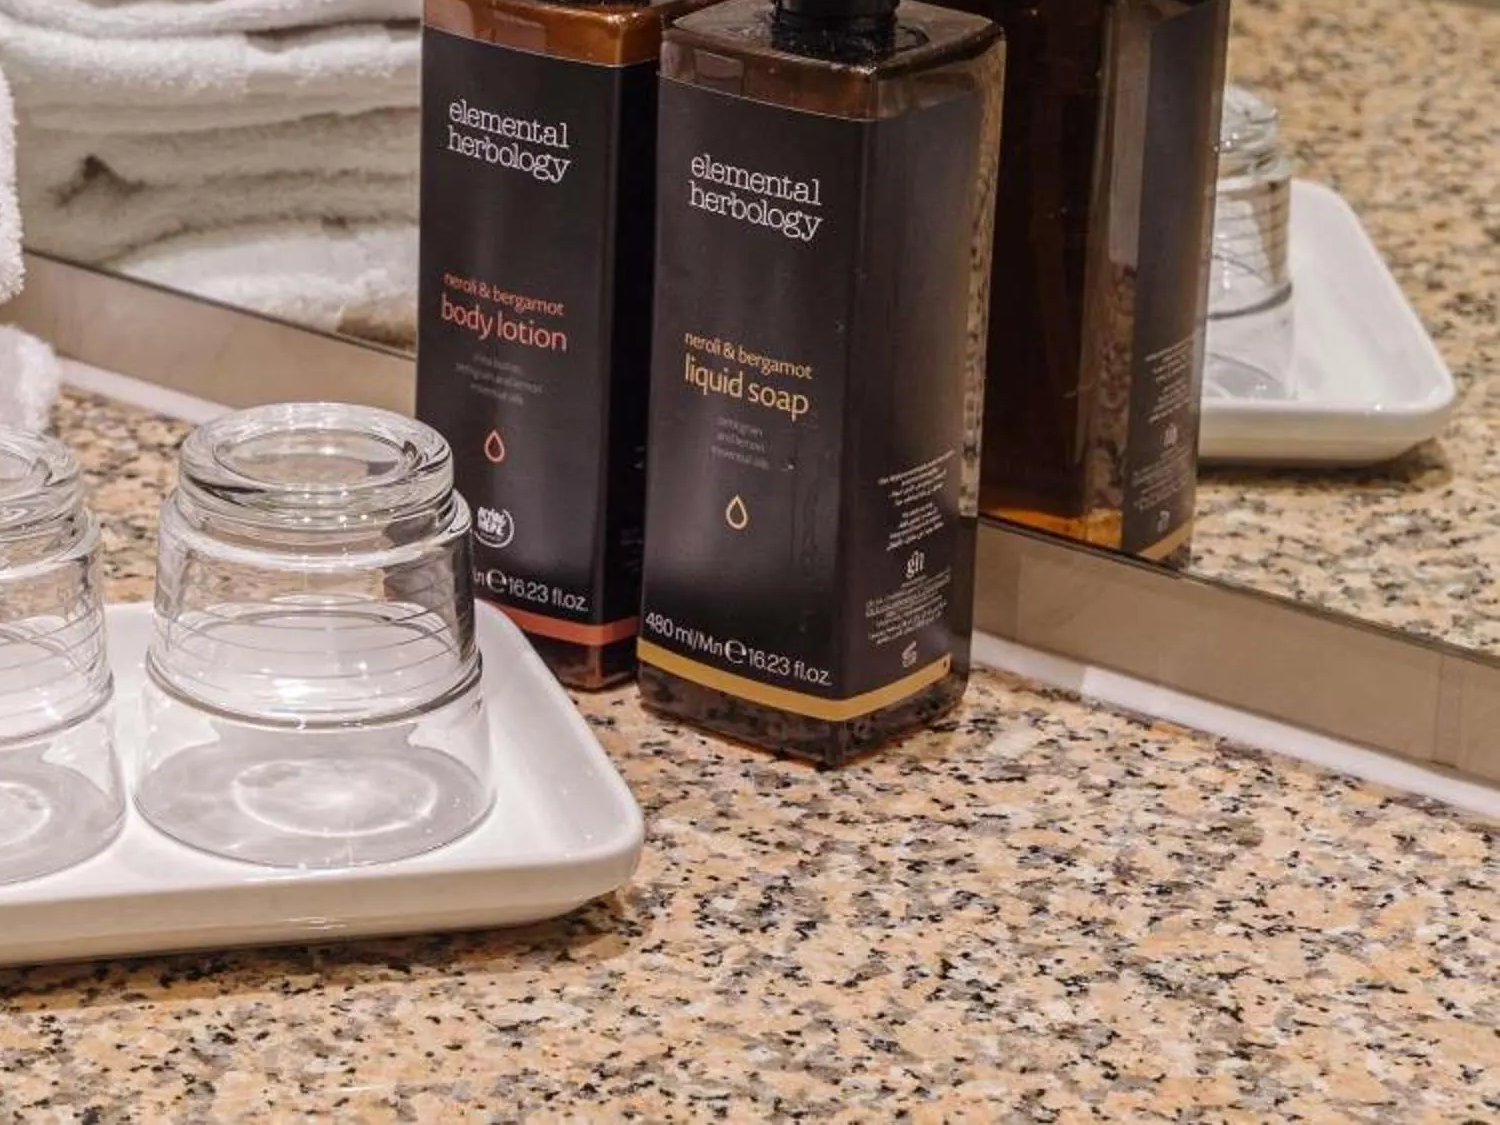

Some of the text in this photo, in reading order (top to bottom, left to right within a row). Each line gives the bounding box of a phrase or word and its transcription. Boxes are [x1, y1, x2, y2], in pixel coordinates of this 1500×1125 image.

[449, 98, 571, 149] elemental
[447, 125, 572, 184] herbology
[690, 152, 823, 207] elemental
[688, 180, 824, 242] herbology
[441, 291, 567, 353] body lotion
[479, 281, 490, 299] &
[492, 284, 565, 316] bergamot
[685, 332, 813, 380] neroli & bergamot
[684, 352, 810, 422] liquid soap
[509, 575, 550, 605] 16.23
[645, 612, 674, 638] 480
[749, 646, 792, 677] 16.23
